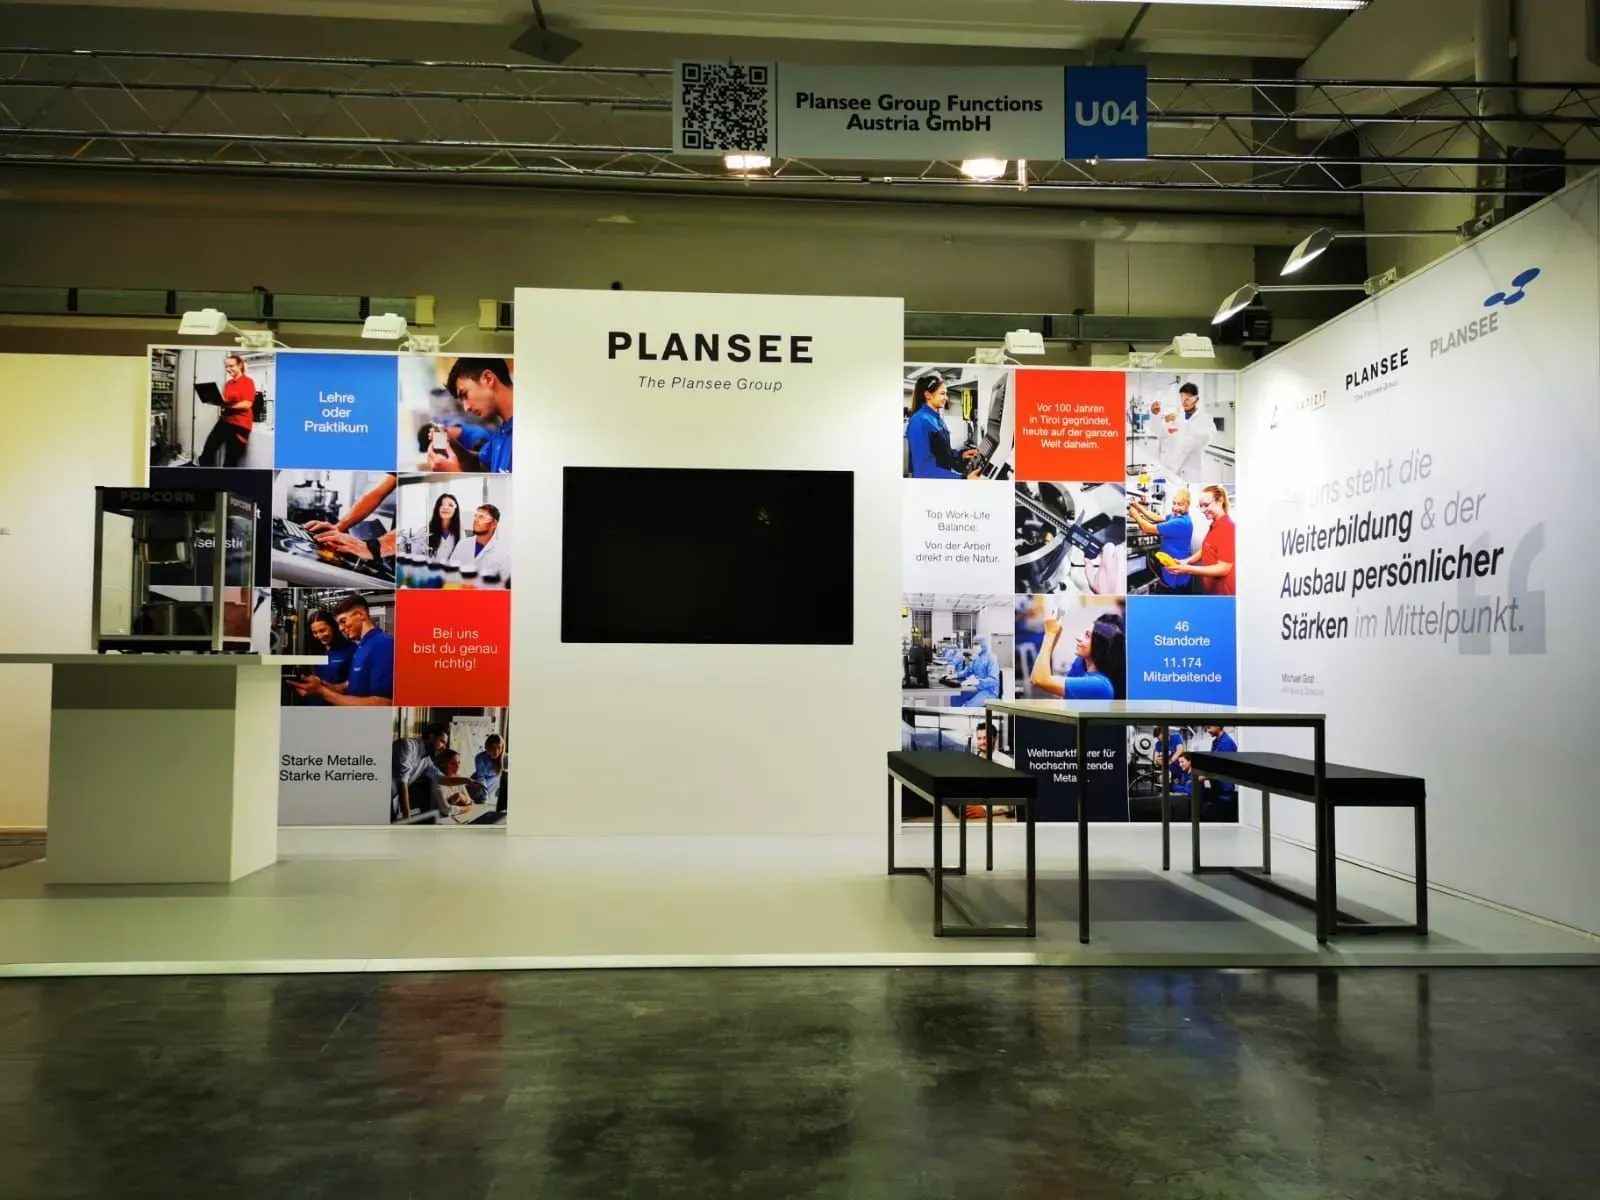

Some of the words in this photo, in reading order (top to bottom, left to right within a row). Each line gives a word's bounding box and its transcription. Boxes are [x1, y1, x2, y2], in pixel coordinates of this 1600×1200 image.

[796, 93, 871, 111] Plansee
[878, 95, 941, 117] Group
[947, 95, 1043, 112] Functions
[1075, 100, 1139, 127] U04
[846, 115, 920, 132] Austria
[927, 114, 992, 132] GmbH
[1429, 311, 1499, 360] PLANSEE
[608, 331, 813, 364] PLANSEE
[1345, 347, 1409, 391] PLANSEE
[638, 376, 666, 388] The
[671, 376, 732, 390] Plansee
[737, 378, 783, 392] Group
[319, 391, 355, 404] Lehre
[322, 406, 352, 418] oder
[1036, 403, 1051, 412] Vor
[1055, 404, 1071, 412] 100
[1074, 403, 1105, 413] Jahren
[1029, 415, 1037, 424] in
[1040, 415, 1060, 424] Tirol
[304, 420, 369, 434] Praktikum
[1022, 426, 1048, 436] heute
[1051, 428, 1066, 436] auf
[1067, 428, 1083, 437] der
[1086, 429, 1118, 438] ganzen
[1041, 439, 1061, 448] Welt
[1063, 440, 1100, 448] daheim.
[1345, 458, 1393, 499] steht
[1399, 448, 1432, 484] die
[120, 490, 197, 504] POPCORN
[927, 509, 943, 520] Top
[946, 510, 991, 520] Work-Life
[1281, 509, 1413, 557] Weiterbildung
[1420, 497, 1436, 531] &
[1443, 491, 1487, 526] der
[925, 541, 943, 550] Von
[945, 541, 961, 550] der
[963, 541, 991, 550] Arbeit
[915, 553, 942, 562] direkt
[944, 554, 953, 562] in
[955, 554, 970, 562] die
[972, 554, 1000, 563] Natur.
[1280, 568, 1346, 599] Ausbau
[1352, 544, 1504, 598] persönlicher
[1281, 611, 1349, 641] Stärken
[1354, 606, 1377, 638] im
[1384, 596, 1524, 643] Mittelpunkt.
[1174, 621, 1190, 632] 46
[432, 628, 453, 640] Bei
[456, 630, 479, 640] uns
[1153, 634, 1211, 648] Standorte
[413, 642, 437, 654] bist
[440, 642, 456, 654] du
[460, 644, 498, 657] genau
[434, 657, 477, 672] richtig!
[1163, 657, 1202, 669] 11.174
[1143, 671, 1222, 684] Mitarbeitende
[1027, 748, 1100, 758] Weltmarktfrer
[1102, 748, 1116, 758] für
[281, 754, 324, 767] Starke
[327, 754, 377, 767] Metalle.
[1029, 761, 1114, 770] hochschmzende
[279, 769, 321, 781] Starke
[324, 769, 378, 782] Karriere.
[1053, 773, 1090, 783] Meta.
